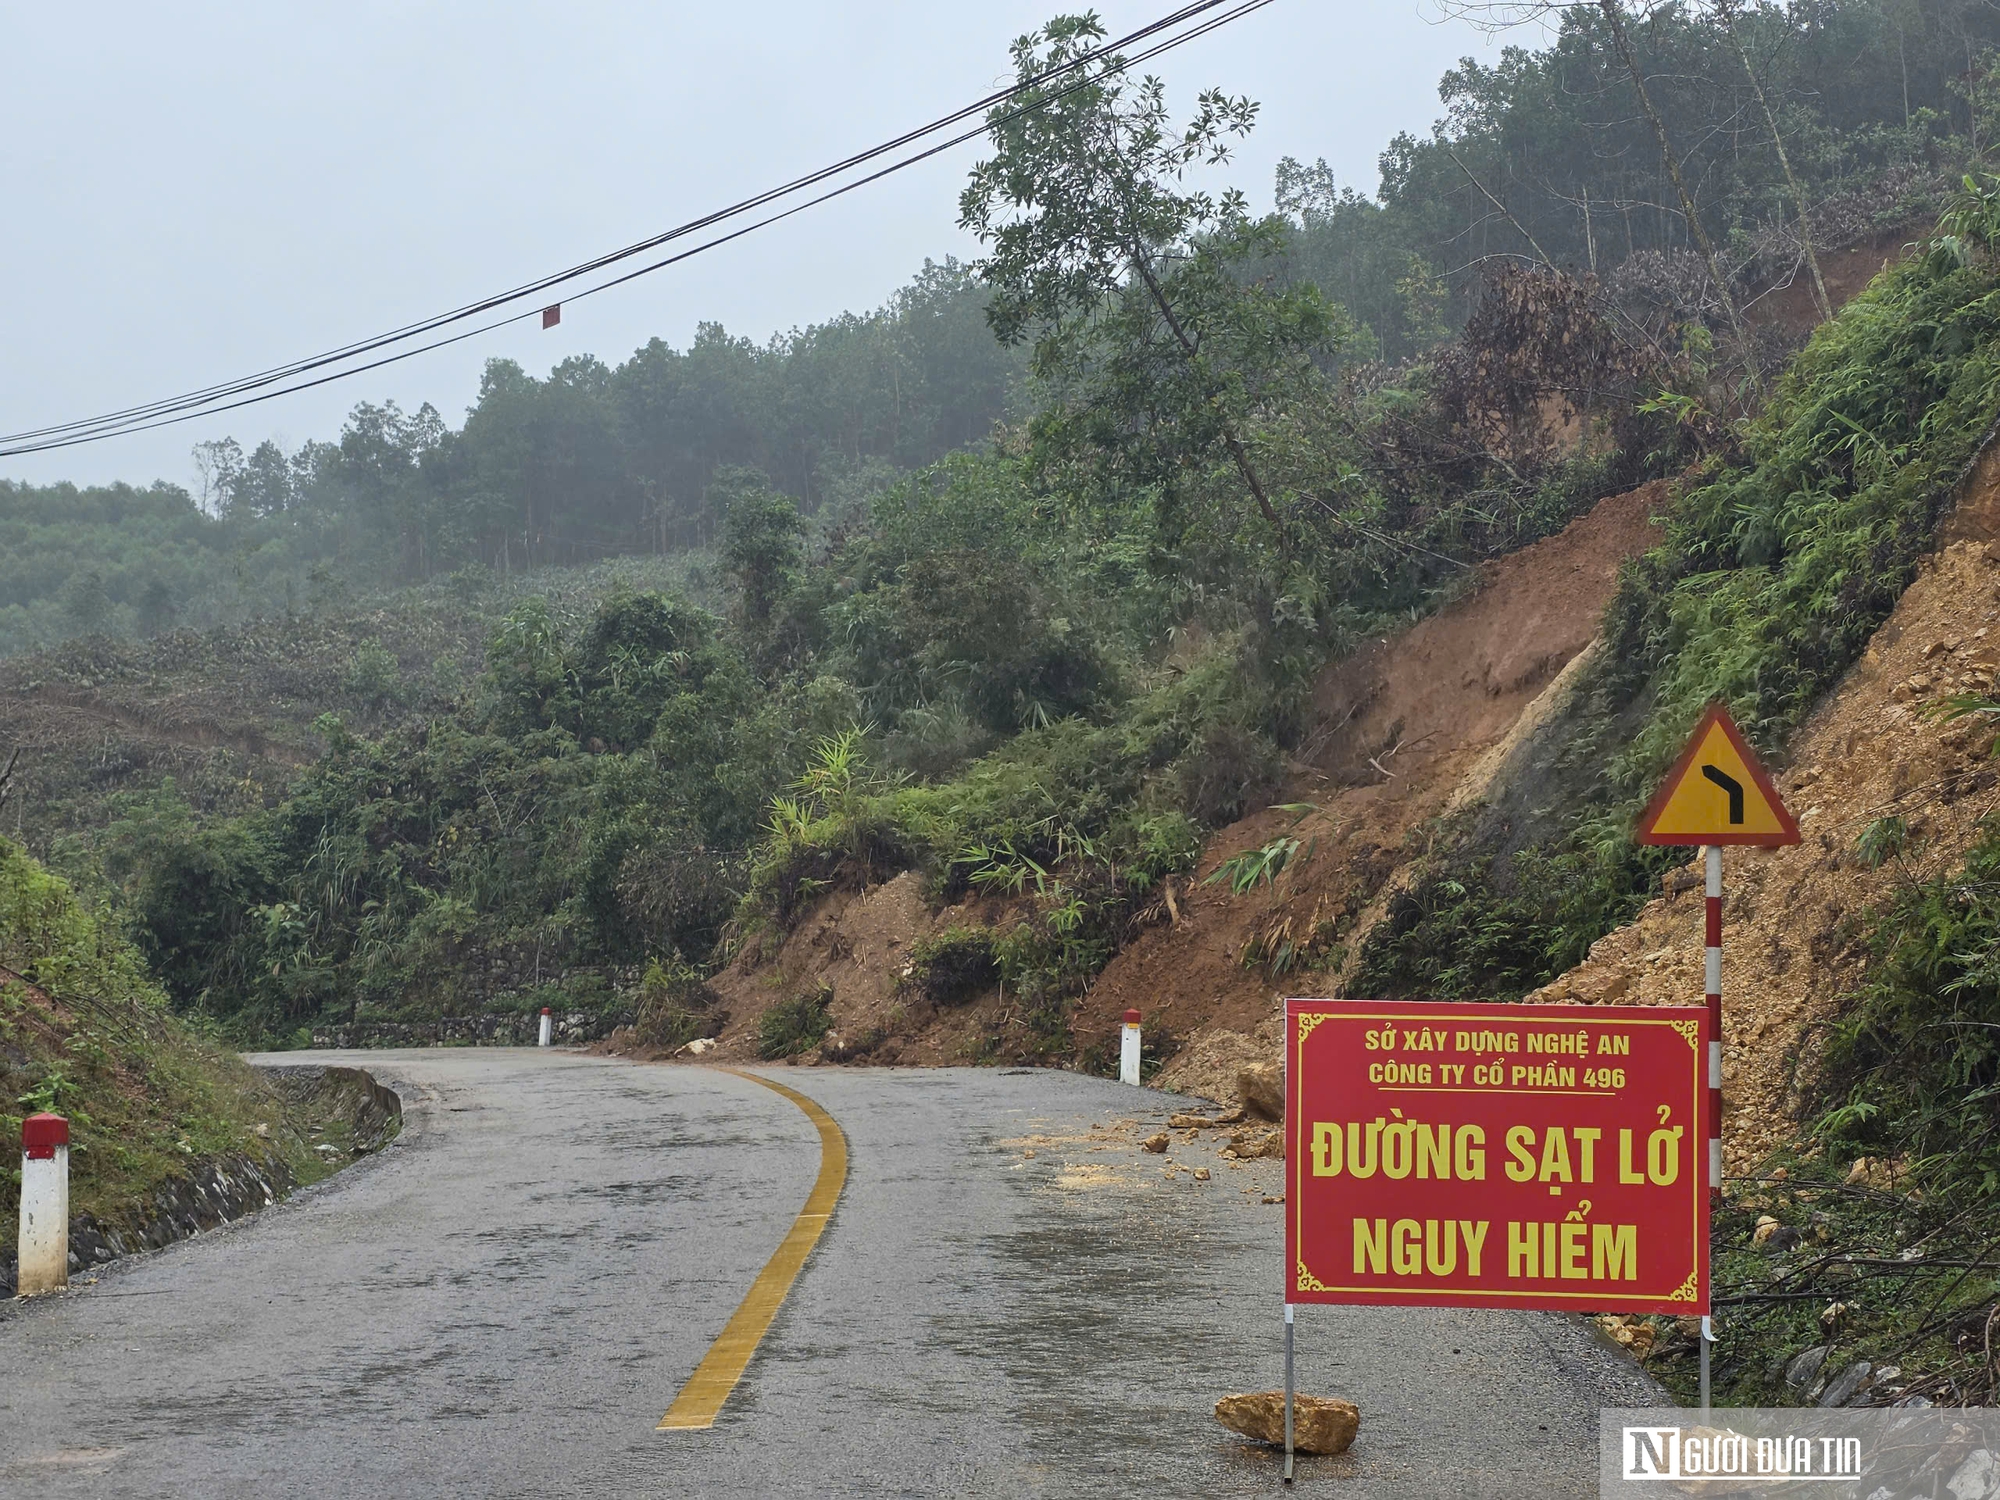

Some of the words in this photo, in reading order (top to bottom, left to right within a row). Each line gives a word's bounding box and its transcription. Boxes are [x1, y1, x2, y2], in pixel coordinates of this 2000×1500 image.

[1365, 1021, 1397, 1050] SỞ
[1403, 1026, 1447, 1051] XÂY
[1455, 1030, 1519, 1056] DỰNG
[1527, 1030, 1589, 1056] NGHỆ
[1596, 1034, 1630, 1056] AN
[1368, 1060, 1432, 1084] CÔNG
[1440, 1064, 1464, 1085] TY
[1473, 1057, 1504, 1086] CỔ
[1512, 1060, 1575, 1087] PHẦN
[1583, 1068, 1626, 1088] 496
[1310, 1108, 1486, 1181] ĐƯỜNG
[1504, 1126, 1601, 1196] SẠT
[1619, 1104, 1683, 1187] LỞ
[1353, 1217, 1489, 1277] NGUY
[1507, 1200, 1637, 1281] HIỂM
